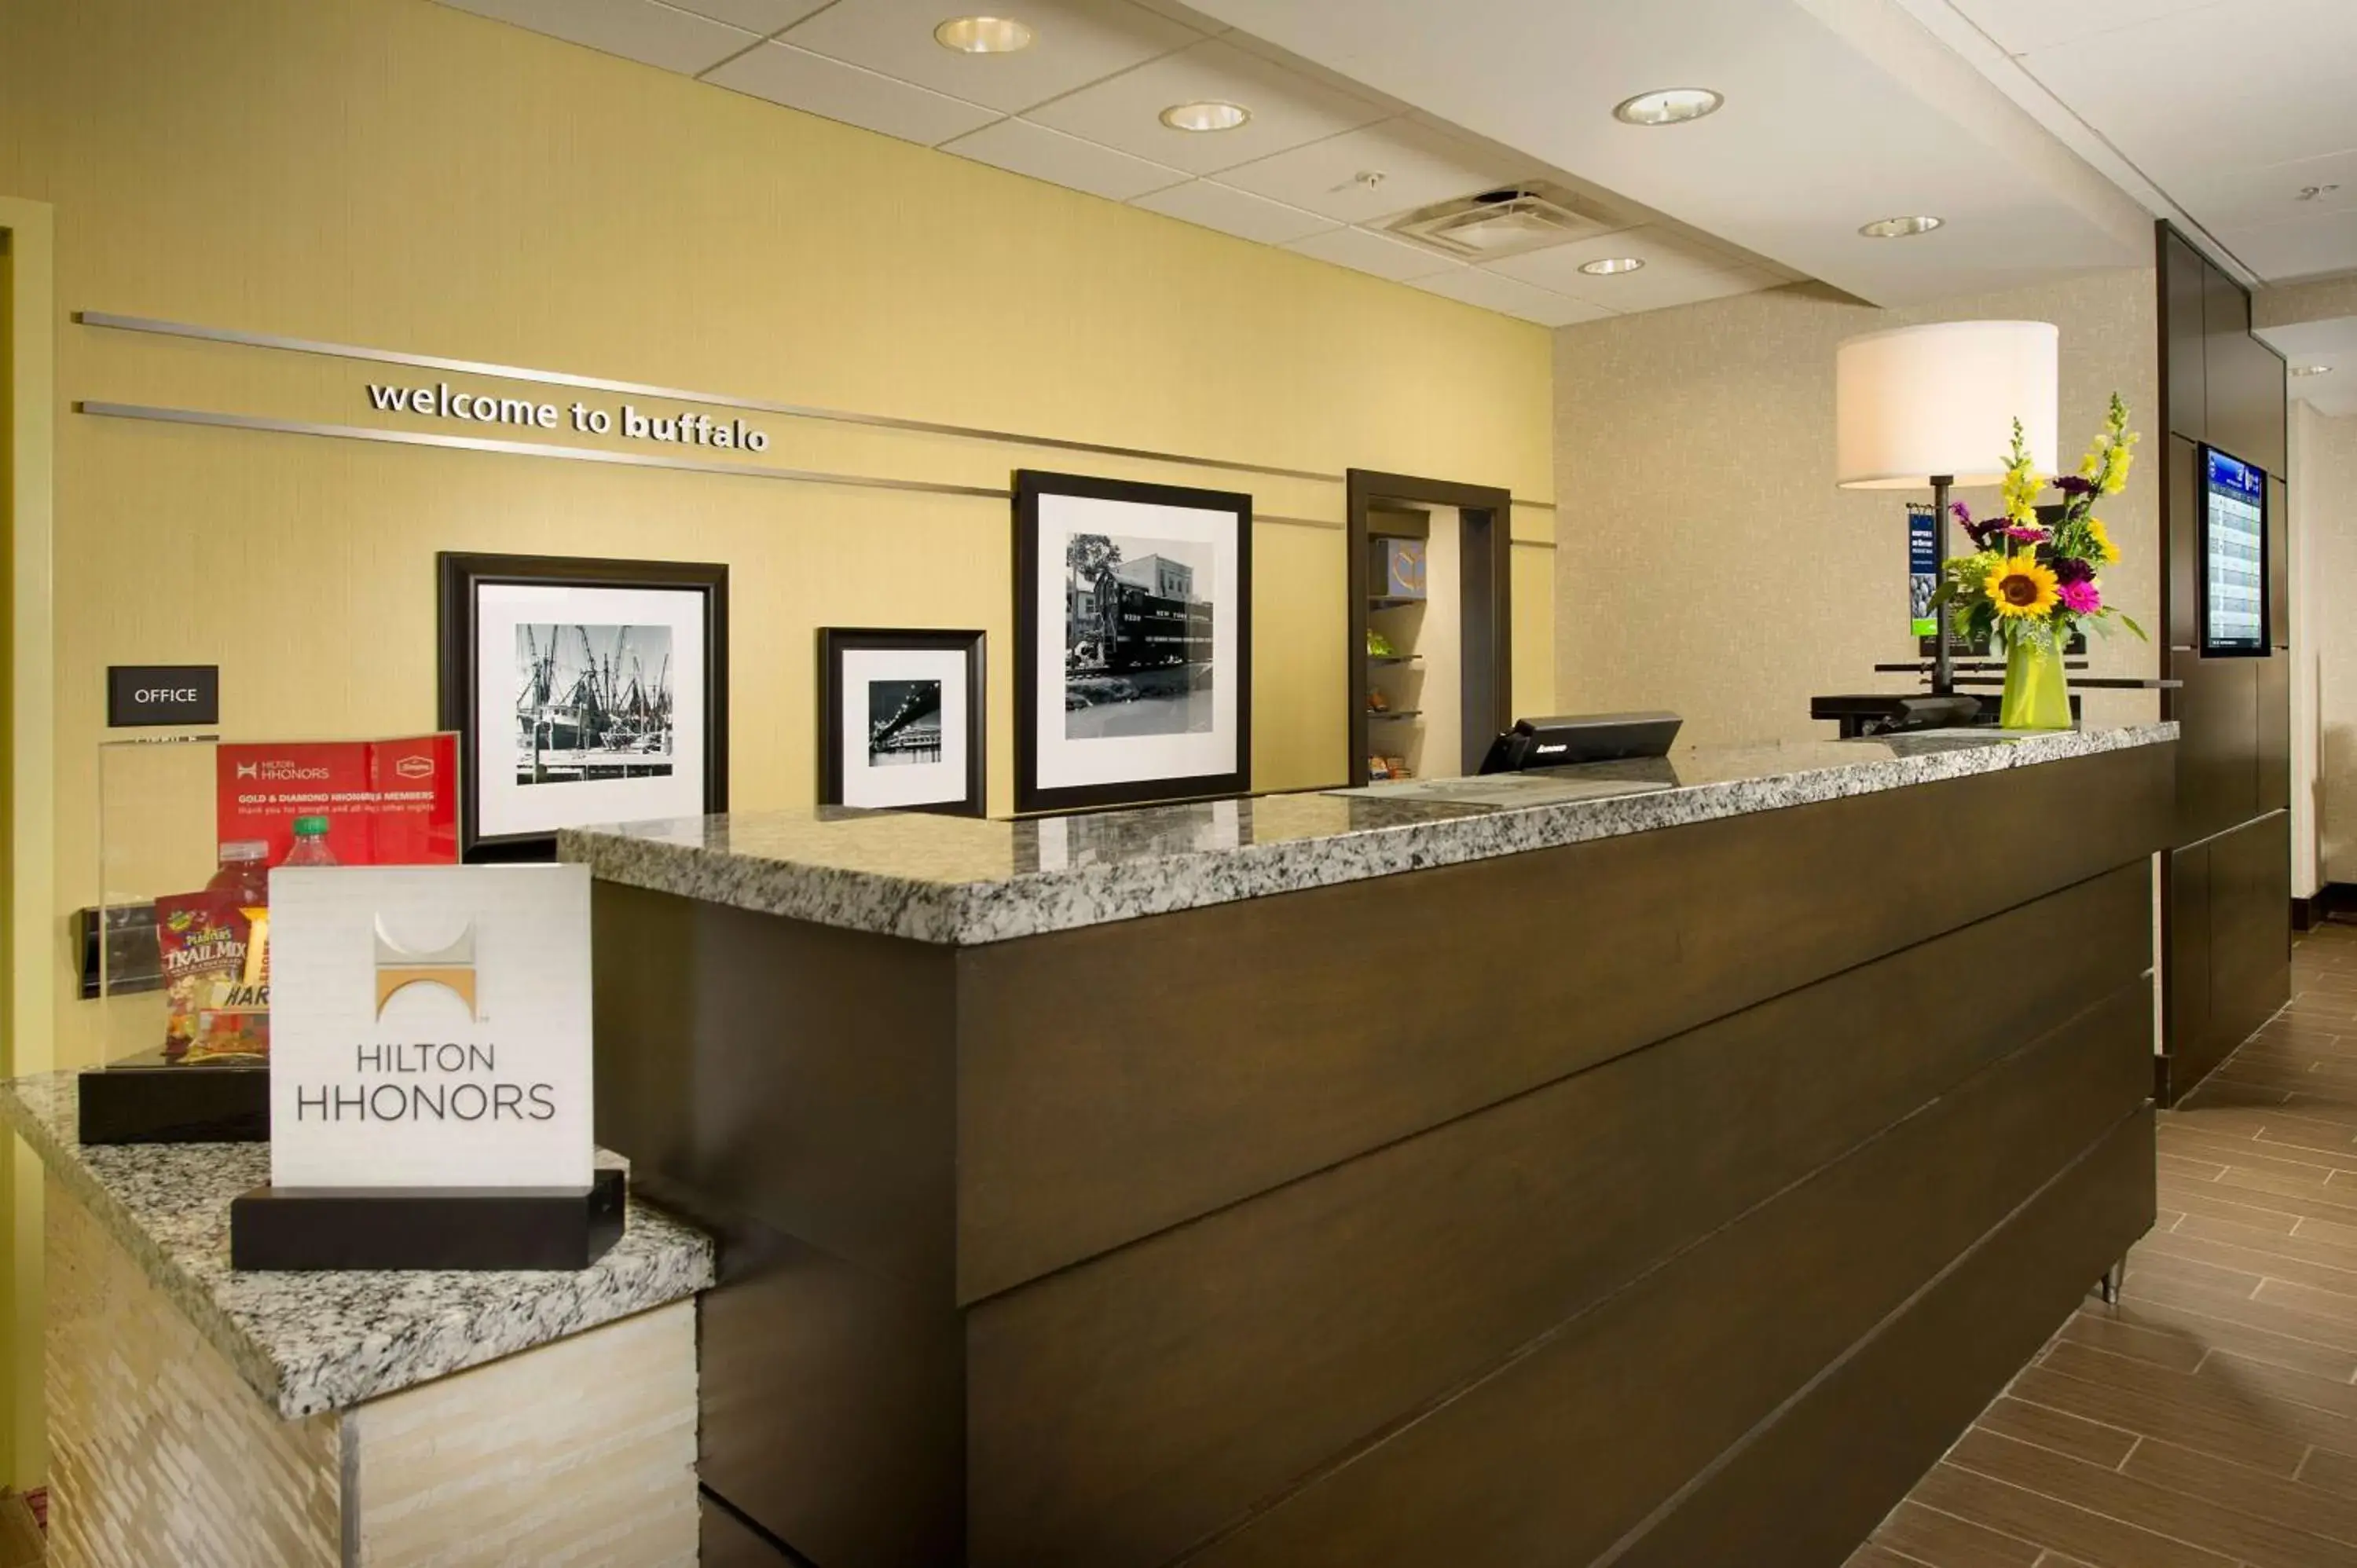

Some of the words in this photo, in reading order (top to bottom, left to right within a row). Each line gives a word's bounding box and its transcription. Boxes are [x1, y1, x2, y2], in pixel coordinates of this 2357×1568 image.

[369, 382, 559, 429] welcome
[570, 401, 611, 434] to
[624, 404, 770, 452] buffalo
[134, 688, 198, 703] OFFICE
[261, 768, 330, 780] HHONORS
[238, 794, 267, 804] GOLD
[278, 793, 329, 803] DIAMOND
[383, 791, 434, 800] MEMBERS
[162, 945, 214, 969] TRAIL
[216, 940, 247, 959] MIX
[357, 1043, 495, 1072] HILTON
[298, 1083, 555, 1121] HHONORS
